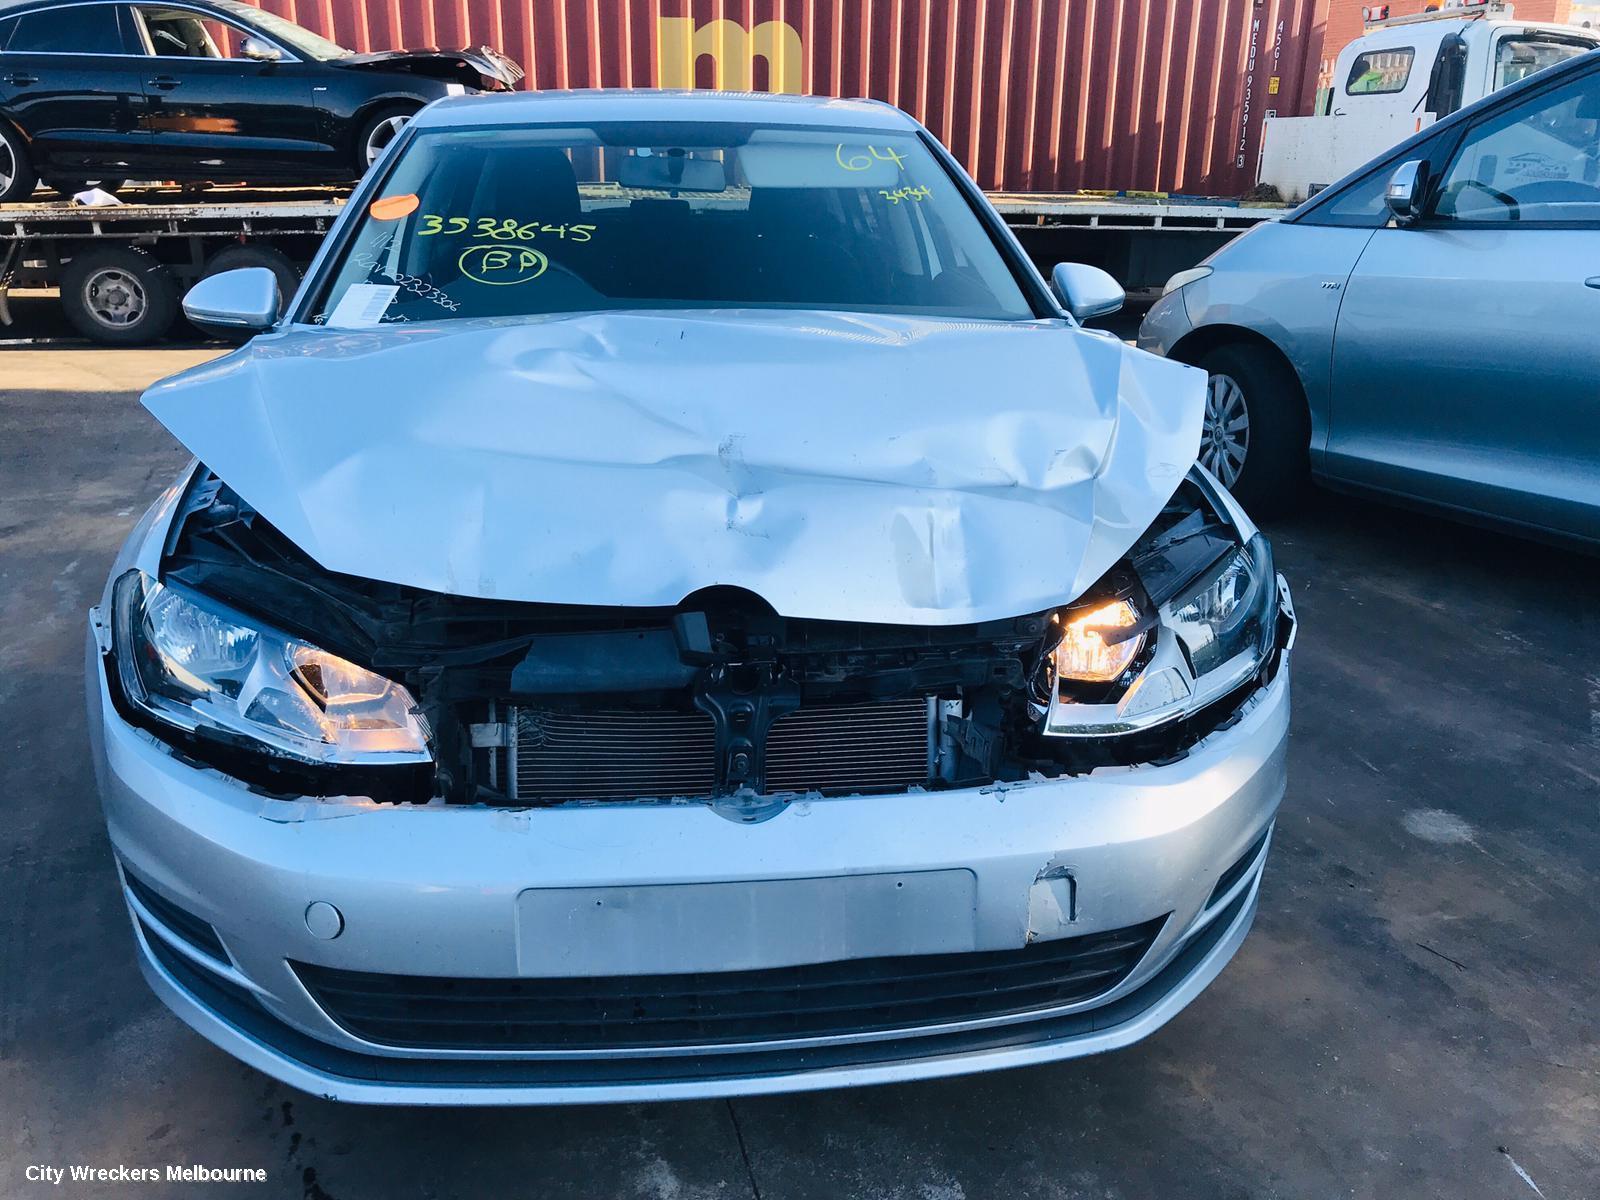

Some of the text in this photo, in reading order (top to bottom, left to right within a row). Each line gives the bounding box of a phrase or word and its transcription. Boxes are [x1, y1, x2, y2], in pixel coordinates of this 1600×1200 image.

[1249, 19, 1260, 72] MEDU
[1273, 20, 1284, 72] 45G1
[1239, 75, 1253, 151] 935912
[836, 143, 909, 171] 64
